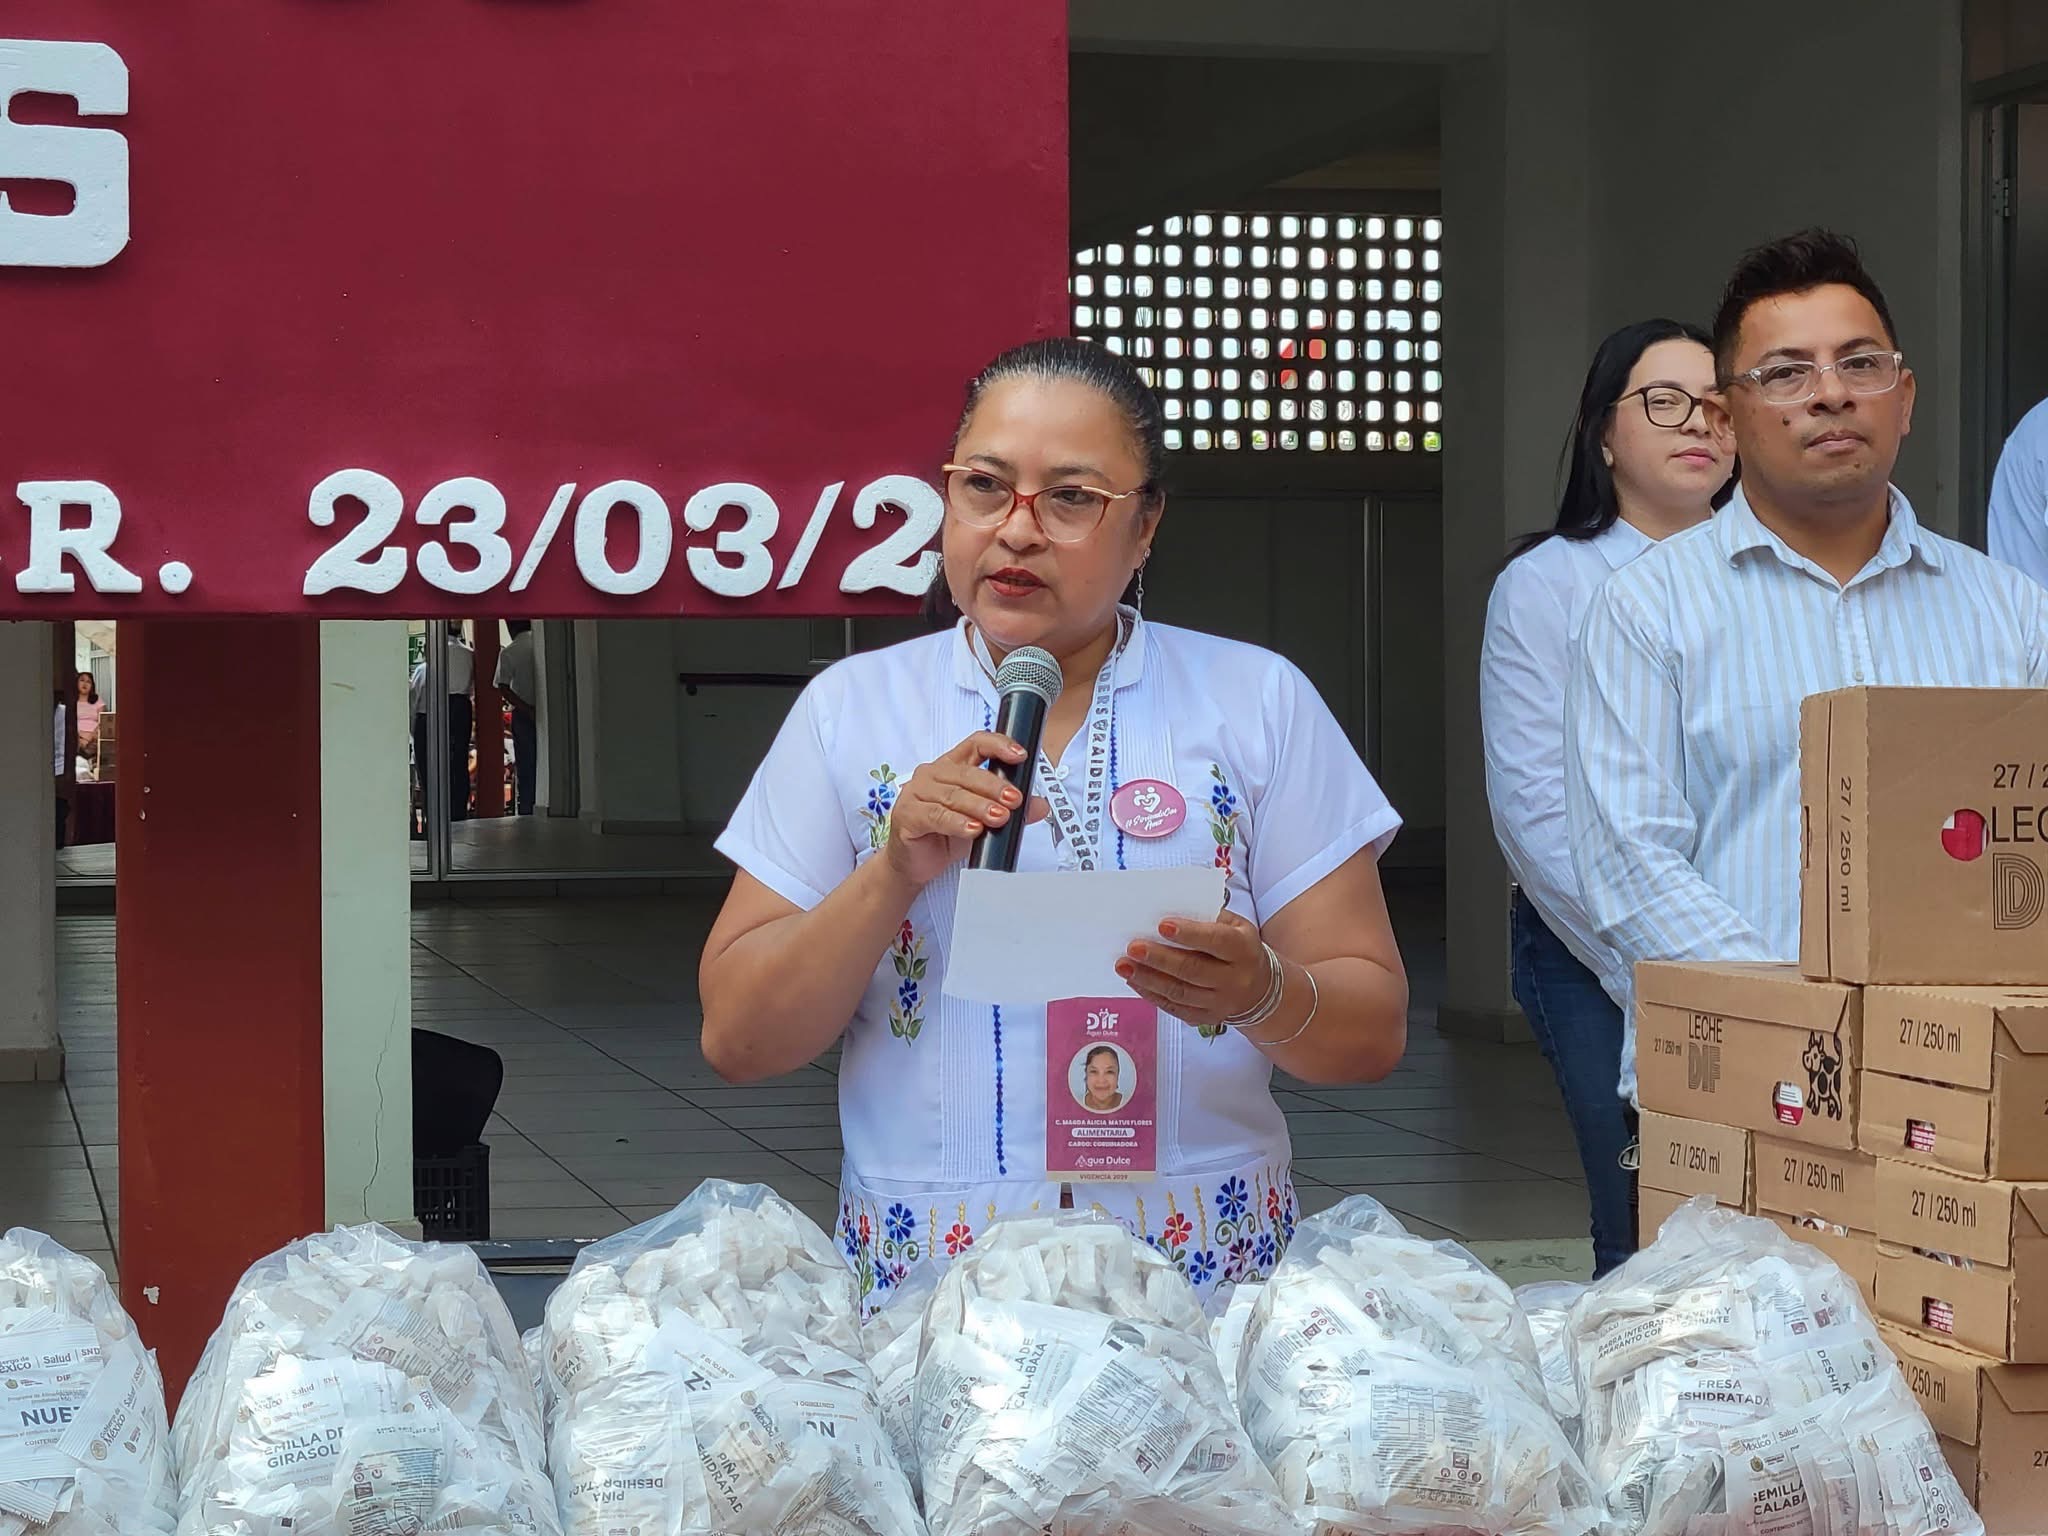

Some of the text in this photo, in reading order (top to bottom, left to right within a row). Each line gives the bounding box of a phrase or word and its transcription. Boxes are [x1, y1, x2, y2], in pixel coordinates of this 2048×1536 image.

[1992, 764, 2020, 789] 27
[1840, 830, 1852, 877] 250
[1841, 885, 1852, 913] ml
[1086, 1008, 1119, 1030] DIF
[1688, 1013, 1723, 1044] LECHE
[1899, 1018, 1915, 1045] 27
[1923, 1024, 1946, 1050] 250
[1946, 1028, 1962, 1054] ml
[1688, 1041, 1721, 1093] DIF
[1076, 1129, 1128, 1137] ALIMENTARIA
[1106, 1156, 1131, 1166] Dulce
[1669, 1142, 1684, 1167] 27
[1689, 1146, 1707, 1171] 250
[1708, 1150, 1721, 1175] ml
[1783, 1158, 1799, 1182] 27
[1806, 1162, 1829, 1188] 250
[1831, 1167, 1845, 1193] ml
[1911, 1190, 1927, 1218] 27
[1935, 1196, 1959, 1226] 250
[1962, 1201, 1977, 1228] ml
[0, 1347, 101, 1374] éxico Salud SND
[1698, 1379, 1742, 1390] FRESA
[1911, 1367, 1931, 1397] 250
[1933, 1376, 1947, 1403] ml
[1677, 1391, 1771, 1408] ESHIDRATADA
[20, 1405, 81, 1427] NUE
[103, 1413, 126, 1447] México
[1778, 1425, 1799, 1439] Salud
[264, 1433, 322, 1456] EMILLA
[267, 1443, 340, 1469] GIRASOL
[697, 1443, 744, 1514] HIDRATAD
[717, 1451, 741, 1484] PIÑA
[592, 1490, 625, 1504] PIÑA
